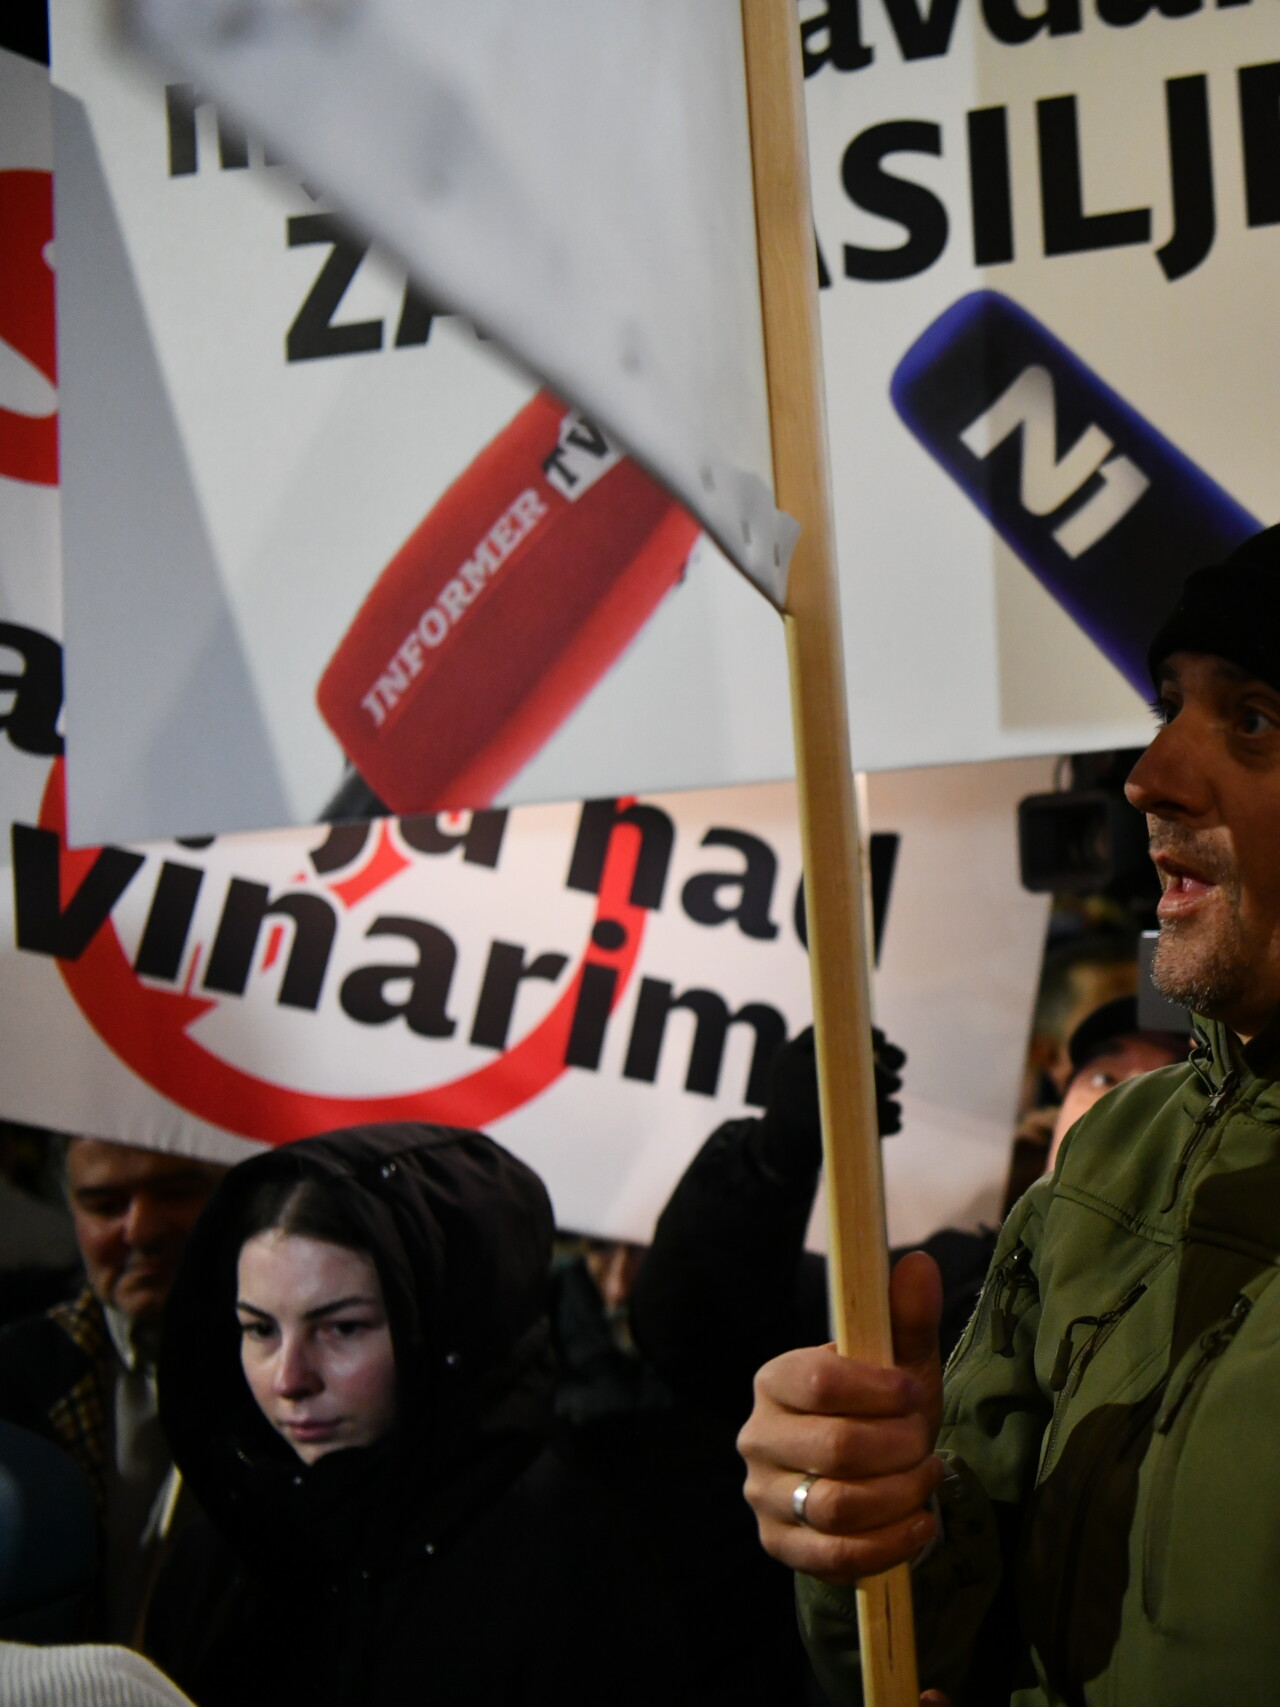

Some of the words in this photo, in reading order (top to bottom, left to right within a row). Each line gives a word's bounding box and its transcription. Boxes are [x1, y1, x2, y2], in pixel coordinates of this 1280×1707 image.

[359, 487, 547, 728] INFORMER
[541, 416, 609, 488] TV
[959, 365, 1151, 560] N1
